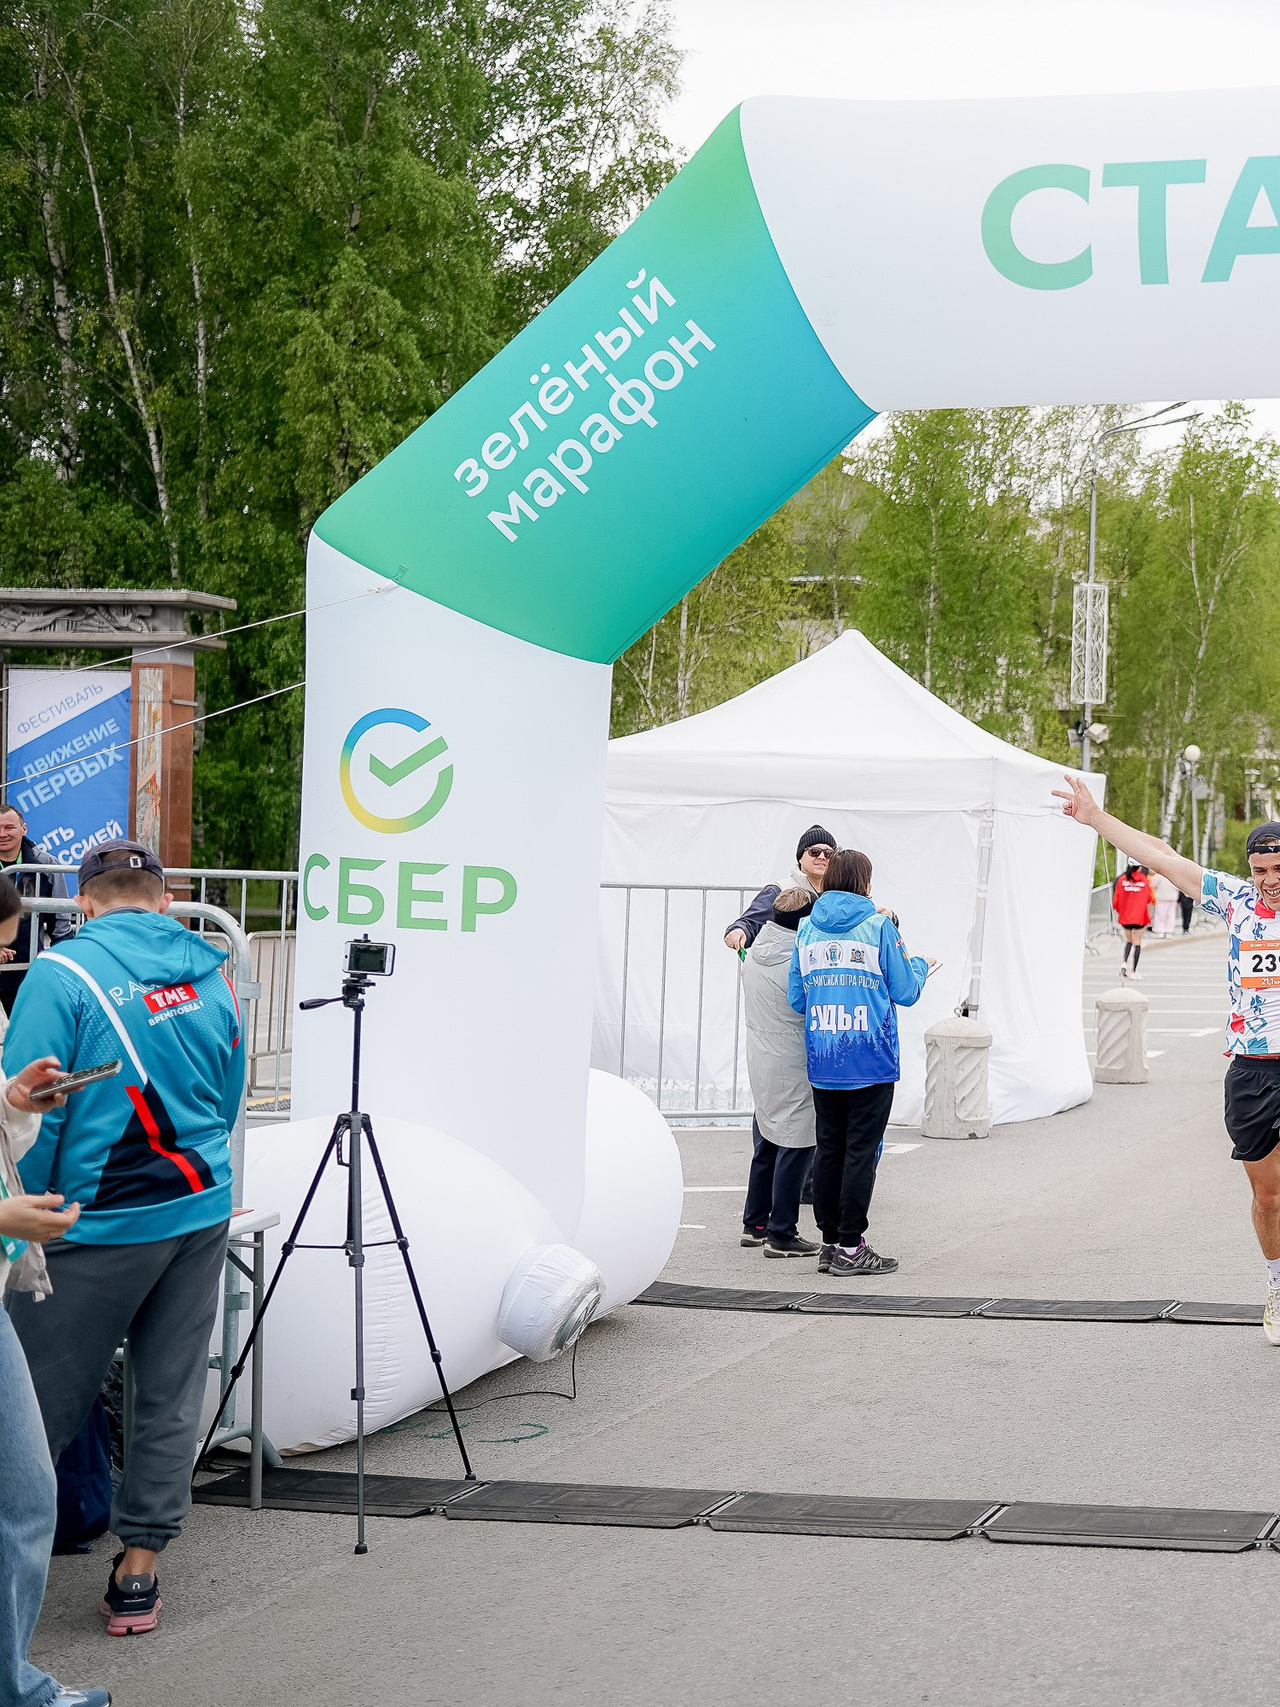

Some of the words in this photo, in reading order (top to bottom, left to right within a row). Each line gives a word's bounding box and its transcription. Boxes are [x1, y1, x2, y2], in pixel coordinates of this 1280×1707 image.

[453, 267, 677, 498] зелёный
[486, 318, 717, 543] марафон
[17, 683, 104, 735] ФЕСТИВАЛЬ
[16, 741, 125, 814] ПЕРВЫХ
[22, 717, 121, 783] ДВИЖЕНИЕ
[36, 825, 75, 853] ЫТЬ
[57, 819, 124, 865] ССИЕЙ
[302, 853, 518, 932] СБЕР
[810, 1004, 869, 1035] СУДЬЯ
